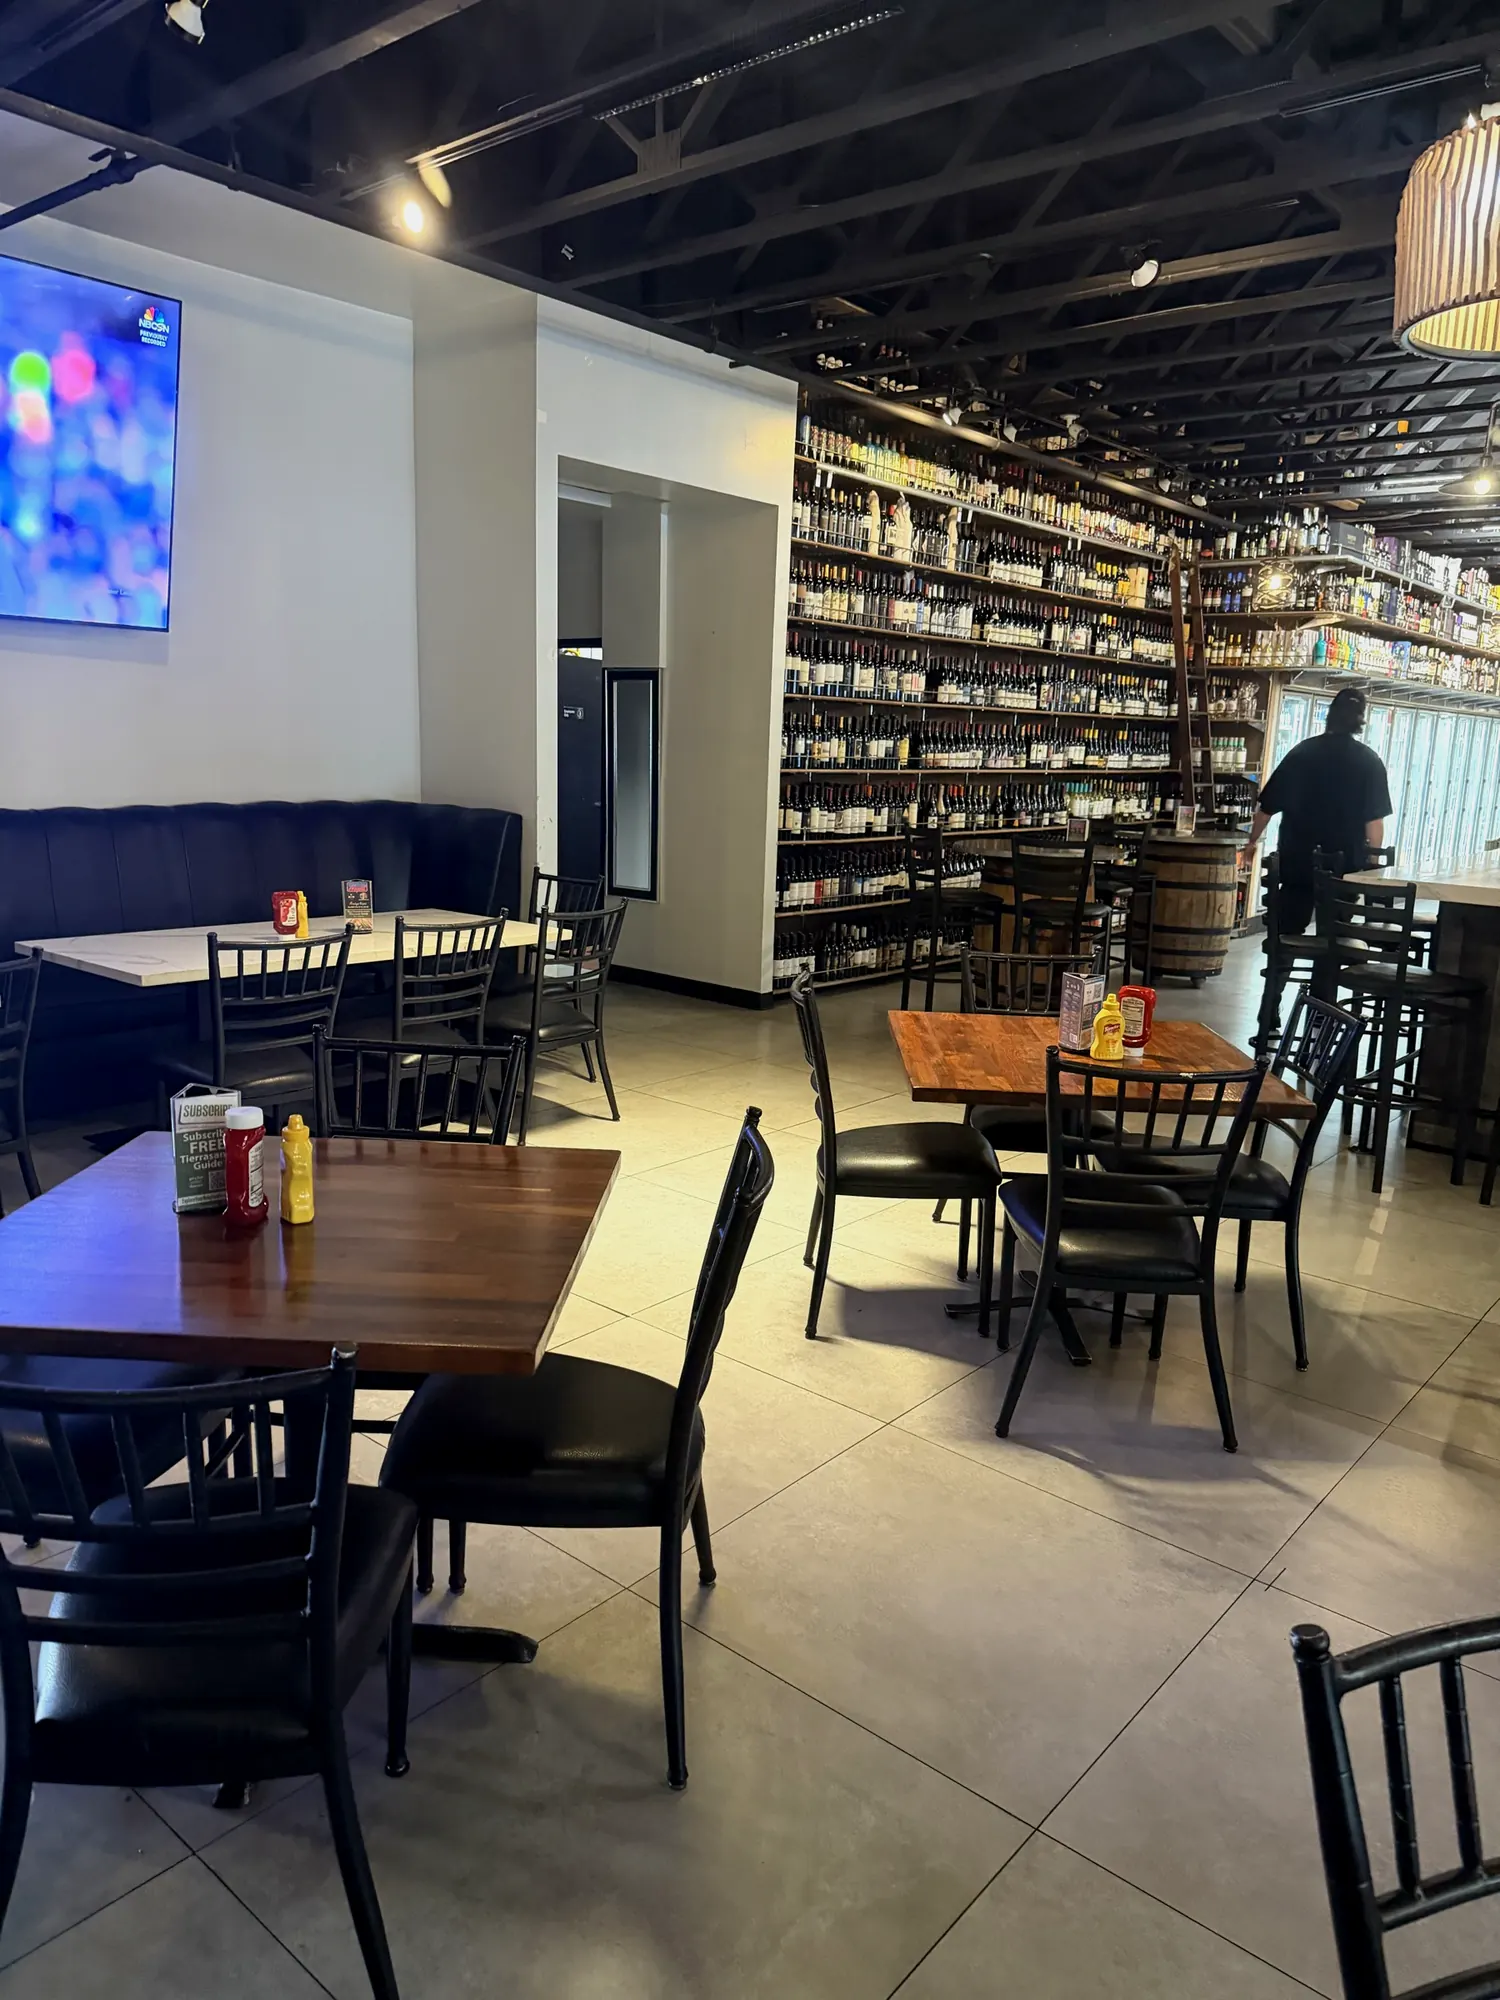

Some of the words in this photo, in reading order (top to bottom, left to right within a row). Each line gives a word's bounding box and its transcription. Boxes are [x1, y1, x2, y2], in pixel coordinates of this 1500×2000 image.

[138, 318, 170, 334] NBCSN
[141, 336, 166, 348] RECORDED
[189, 1138, 225, 1154] FREE
[193, 1159, 223, 1170] Guide
